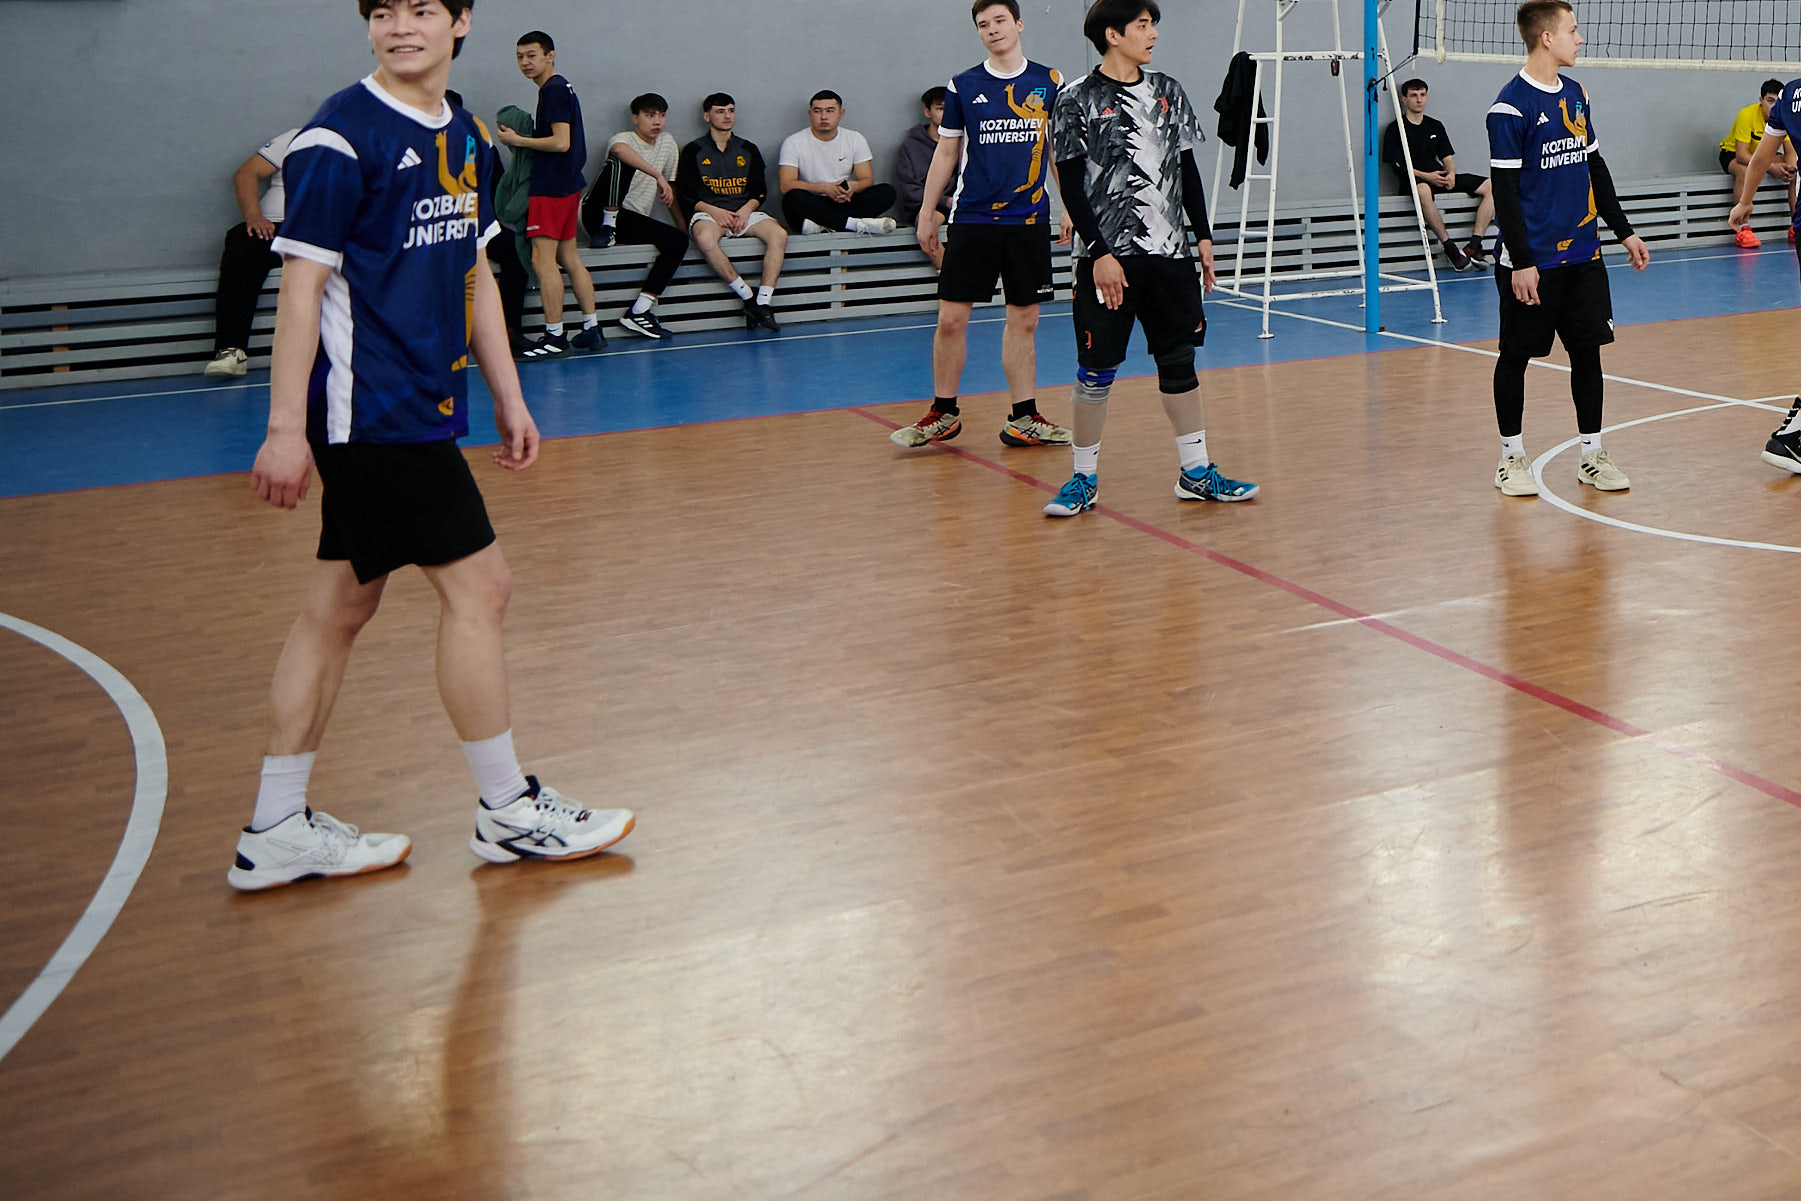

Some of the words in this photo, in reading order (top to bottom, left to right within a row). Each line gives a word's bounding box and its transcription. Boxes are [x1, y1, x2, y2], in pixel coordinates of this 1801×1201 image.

[979, 118, 1044, 132] KOZYBAYEV
[979, 131, 1042, 145] UNIVERSITY
[1540, 149, 1588, 169] UNIVERSIT
[702, 175, 747, 187] Emirates
